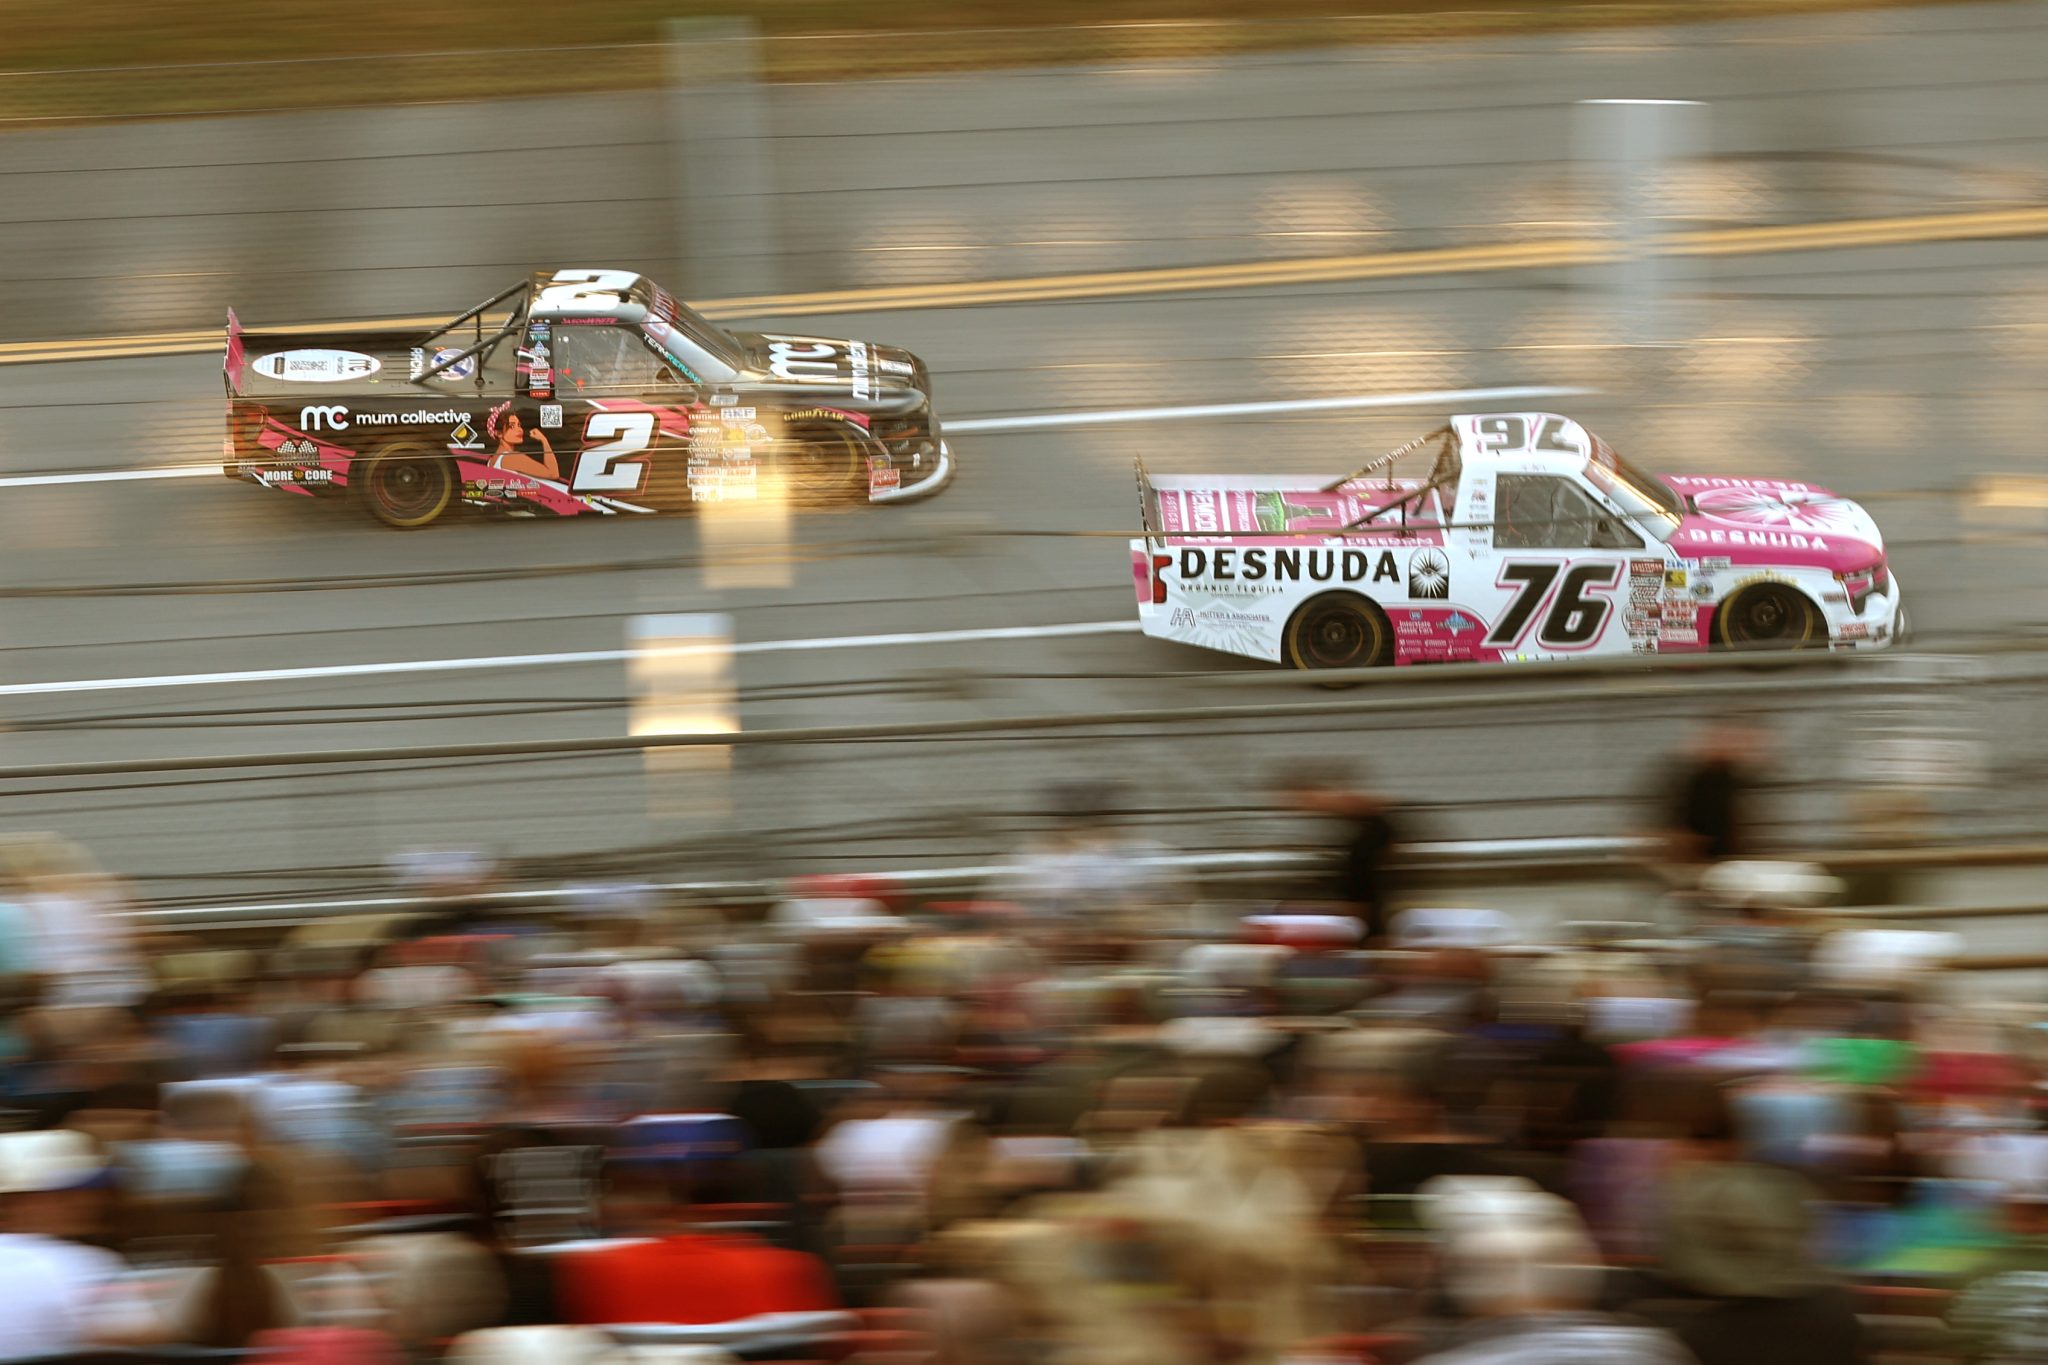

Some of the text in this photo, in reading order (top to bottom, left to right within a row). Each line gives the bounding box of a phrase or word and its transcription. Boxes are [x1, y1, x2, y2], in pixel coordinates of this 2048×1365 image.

[300, 405, 350, 431] mc
[356, 409, 472, 425] mum collective
[783, 407, 845, 421] GOODYEAR
[1478, 415, 1582, 454] 76
[572, 411, 656, 491] 2
[263, 469, 333, 481] MORE CORE
[1689, 528, 1829, 551] DESNUDA
[1179, 548, 1401, 583] DESNUDA
[1180, 583, 1284, 594] ORGANIC TEQUILA
[1483, 560, 1622, 649] 76
